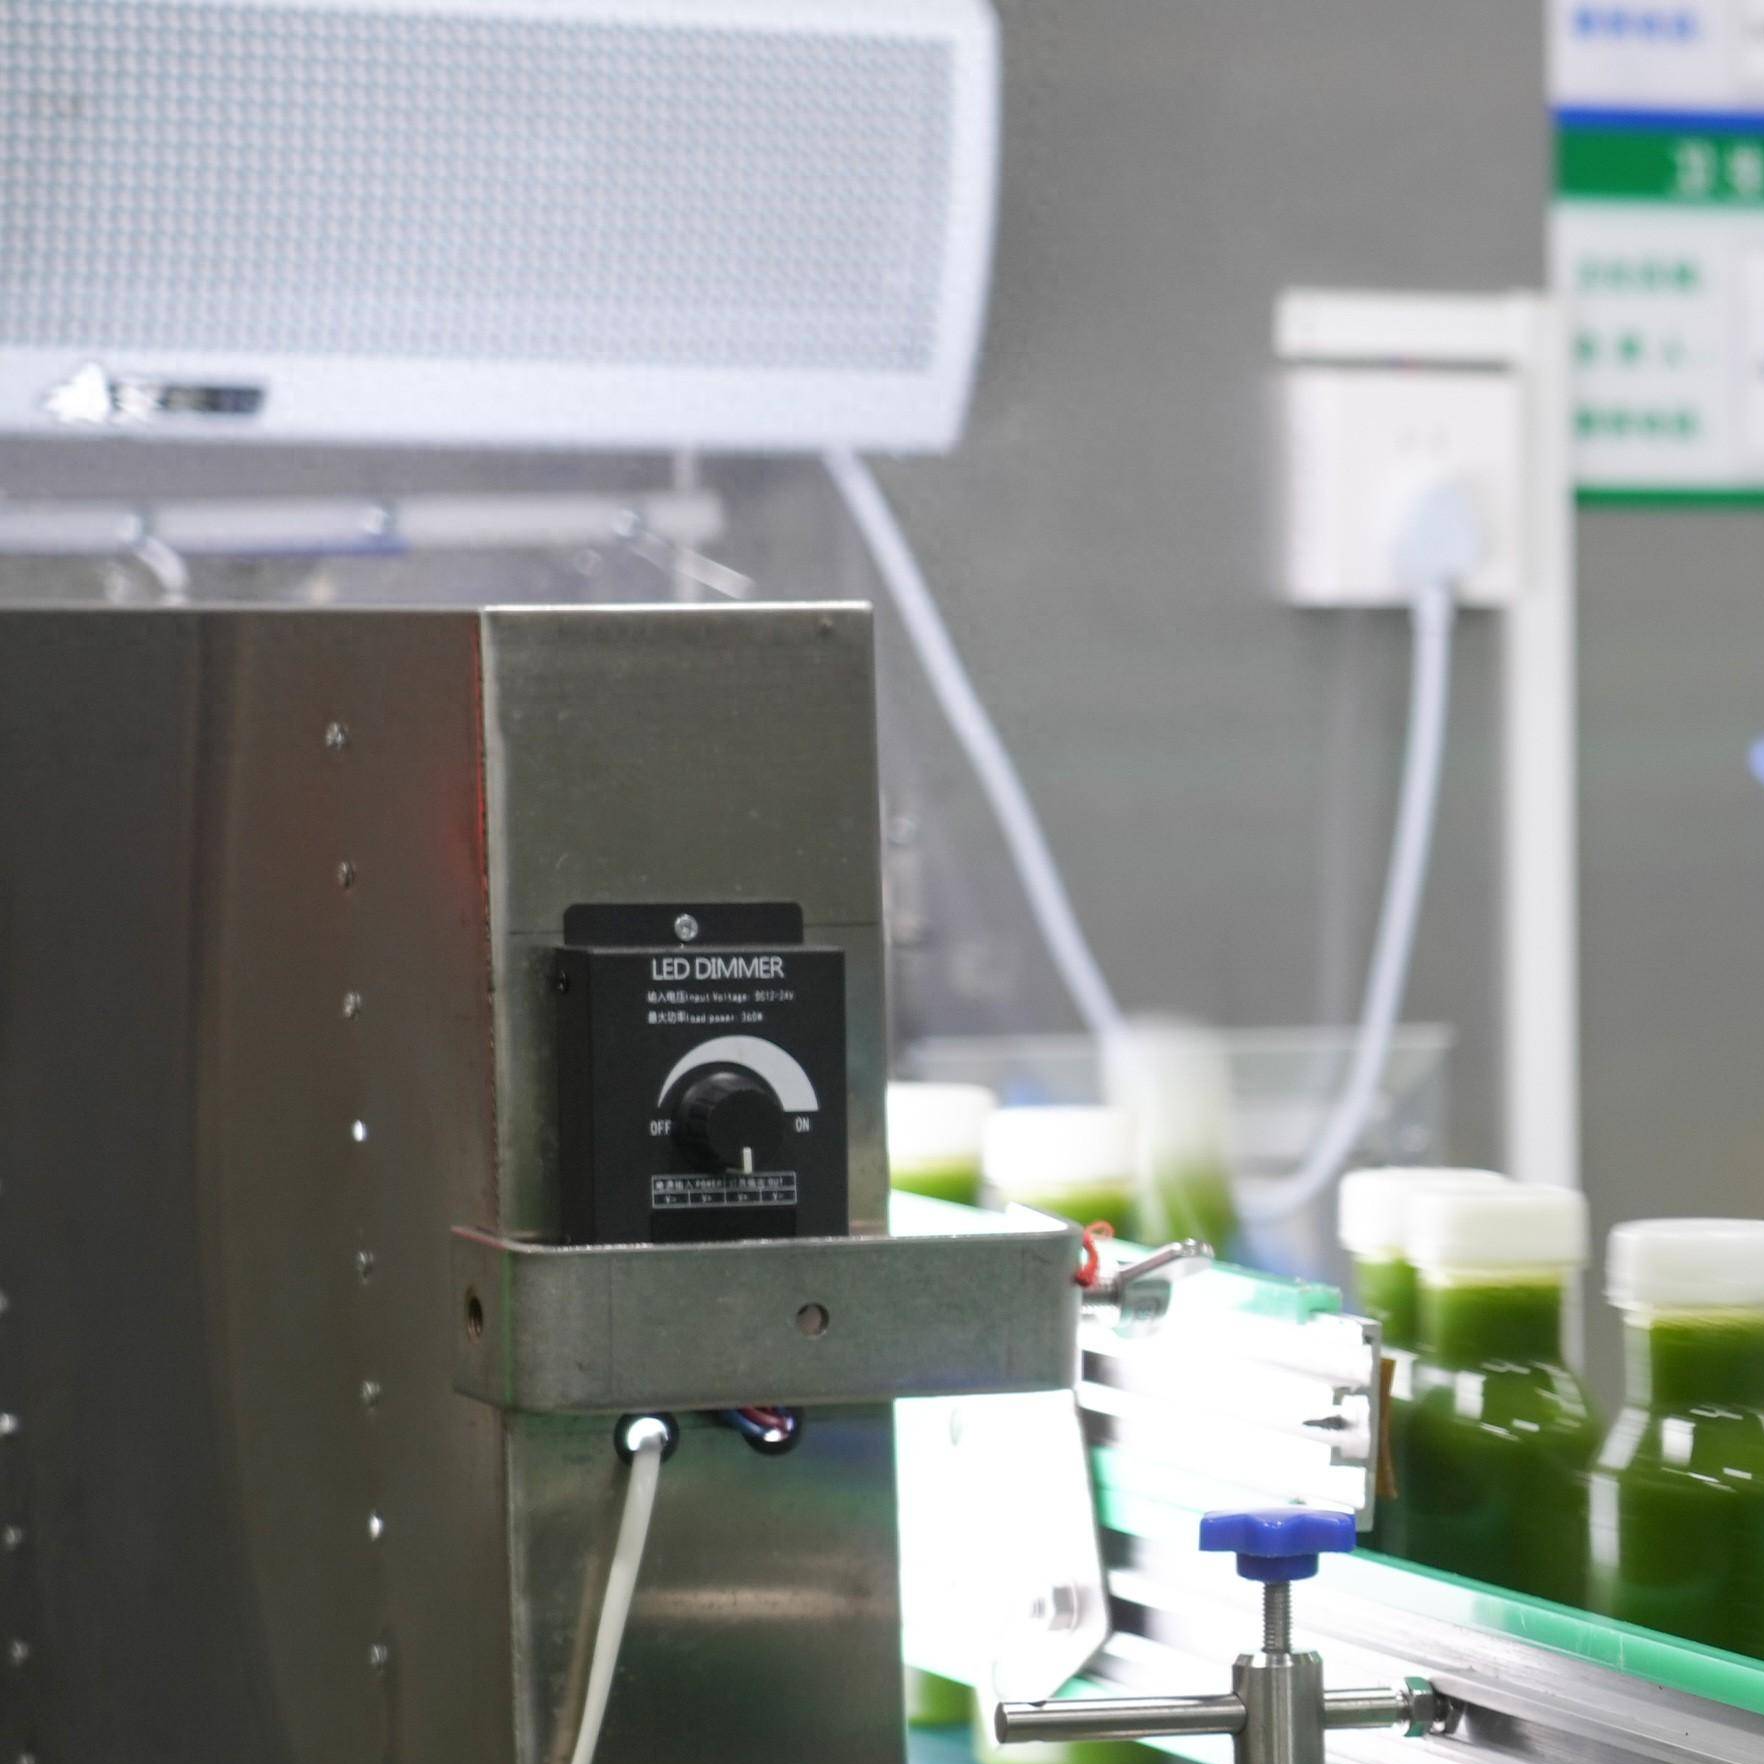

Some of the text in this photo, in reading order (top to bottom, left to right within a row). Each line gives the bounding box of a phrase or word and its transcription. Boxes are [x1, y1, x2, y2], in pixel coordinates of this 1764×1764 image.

[652, 955, 785, 980] LED DIMMER
[650, 1120, 672, 1136] OFF
[795, 1116, 810, 1132] ON
